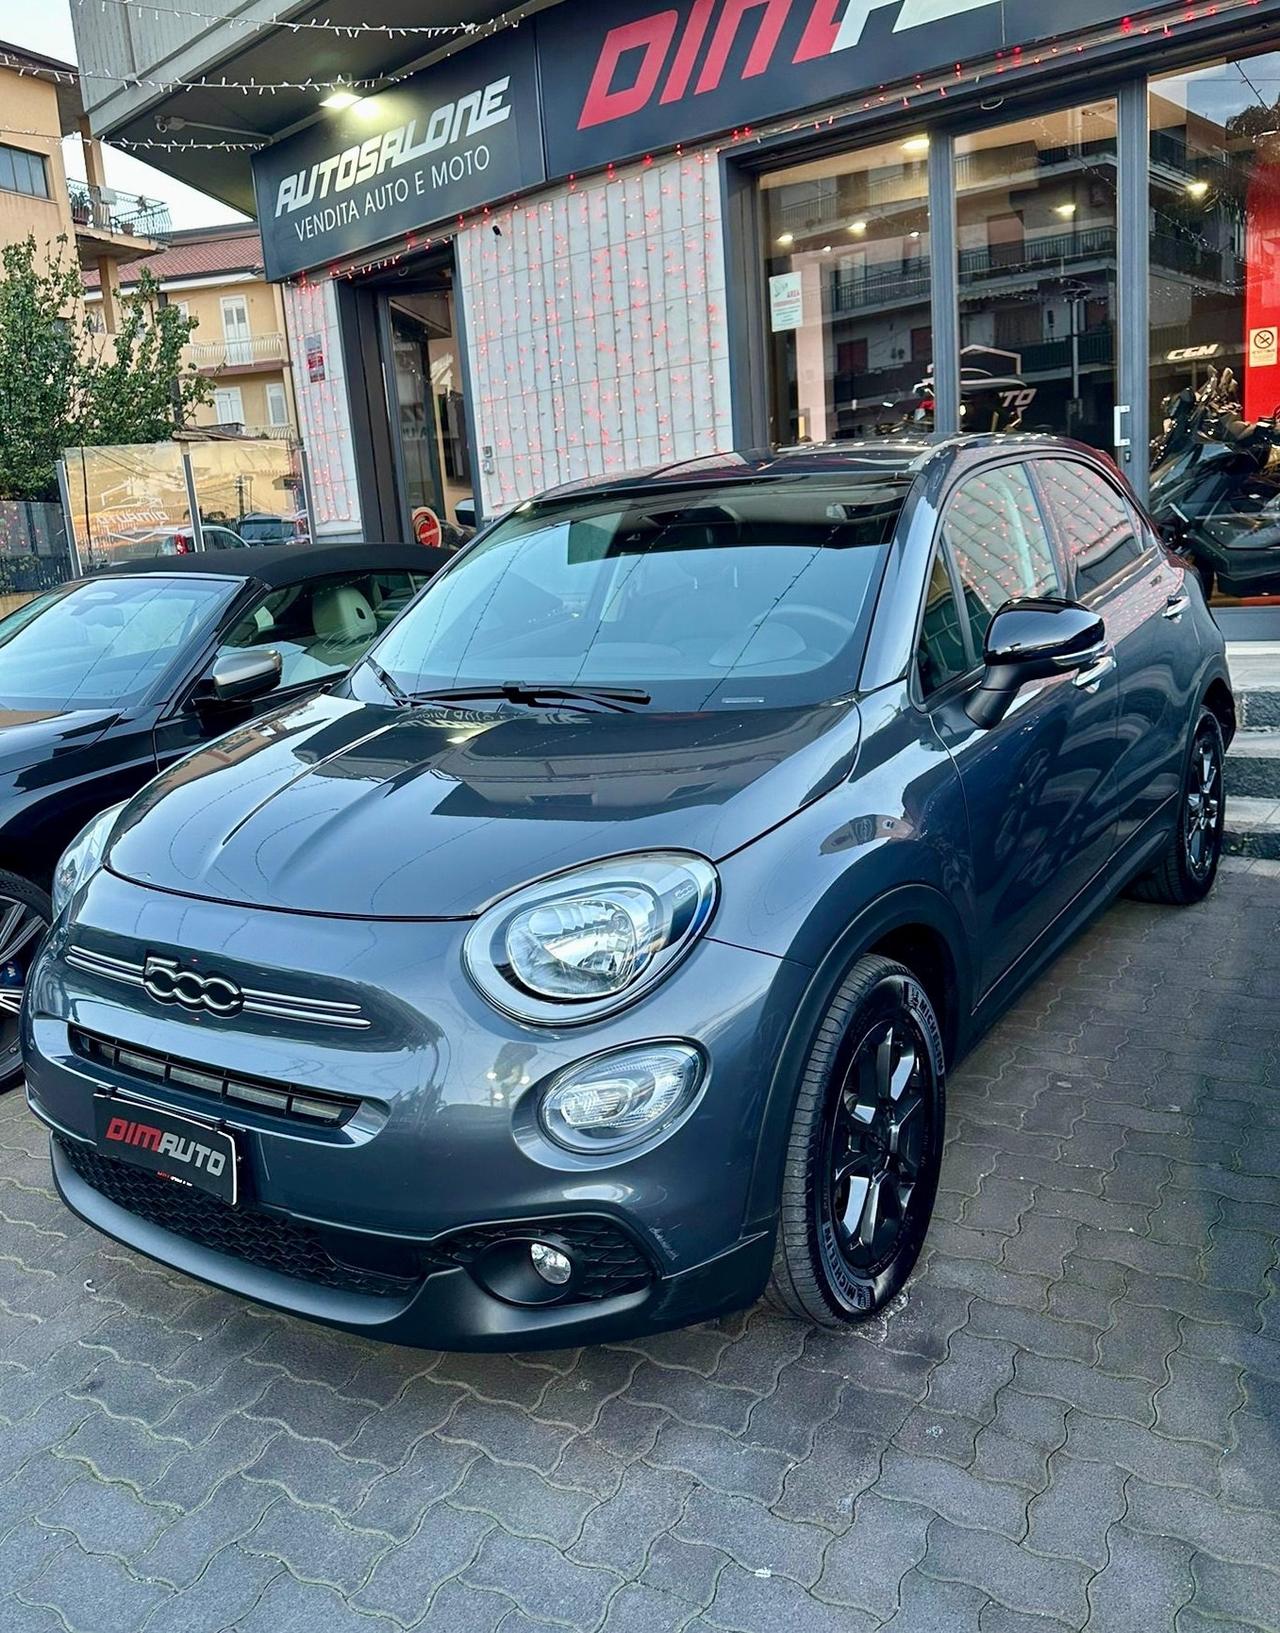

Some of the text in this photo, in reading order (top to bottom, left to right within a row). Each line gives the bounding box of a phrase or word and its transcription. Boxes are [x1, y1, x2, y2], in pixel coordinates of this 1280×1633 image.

[274, 75, 512, 218] AUTOSALONE
[294, 145, 490, 242] VENDITA AUTO E MOTO
[144, 956, 241, 1011] 500
[105, 1117, 226, 1177] DIMAUTO
